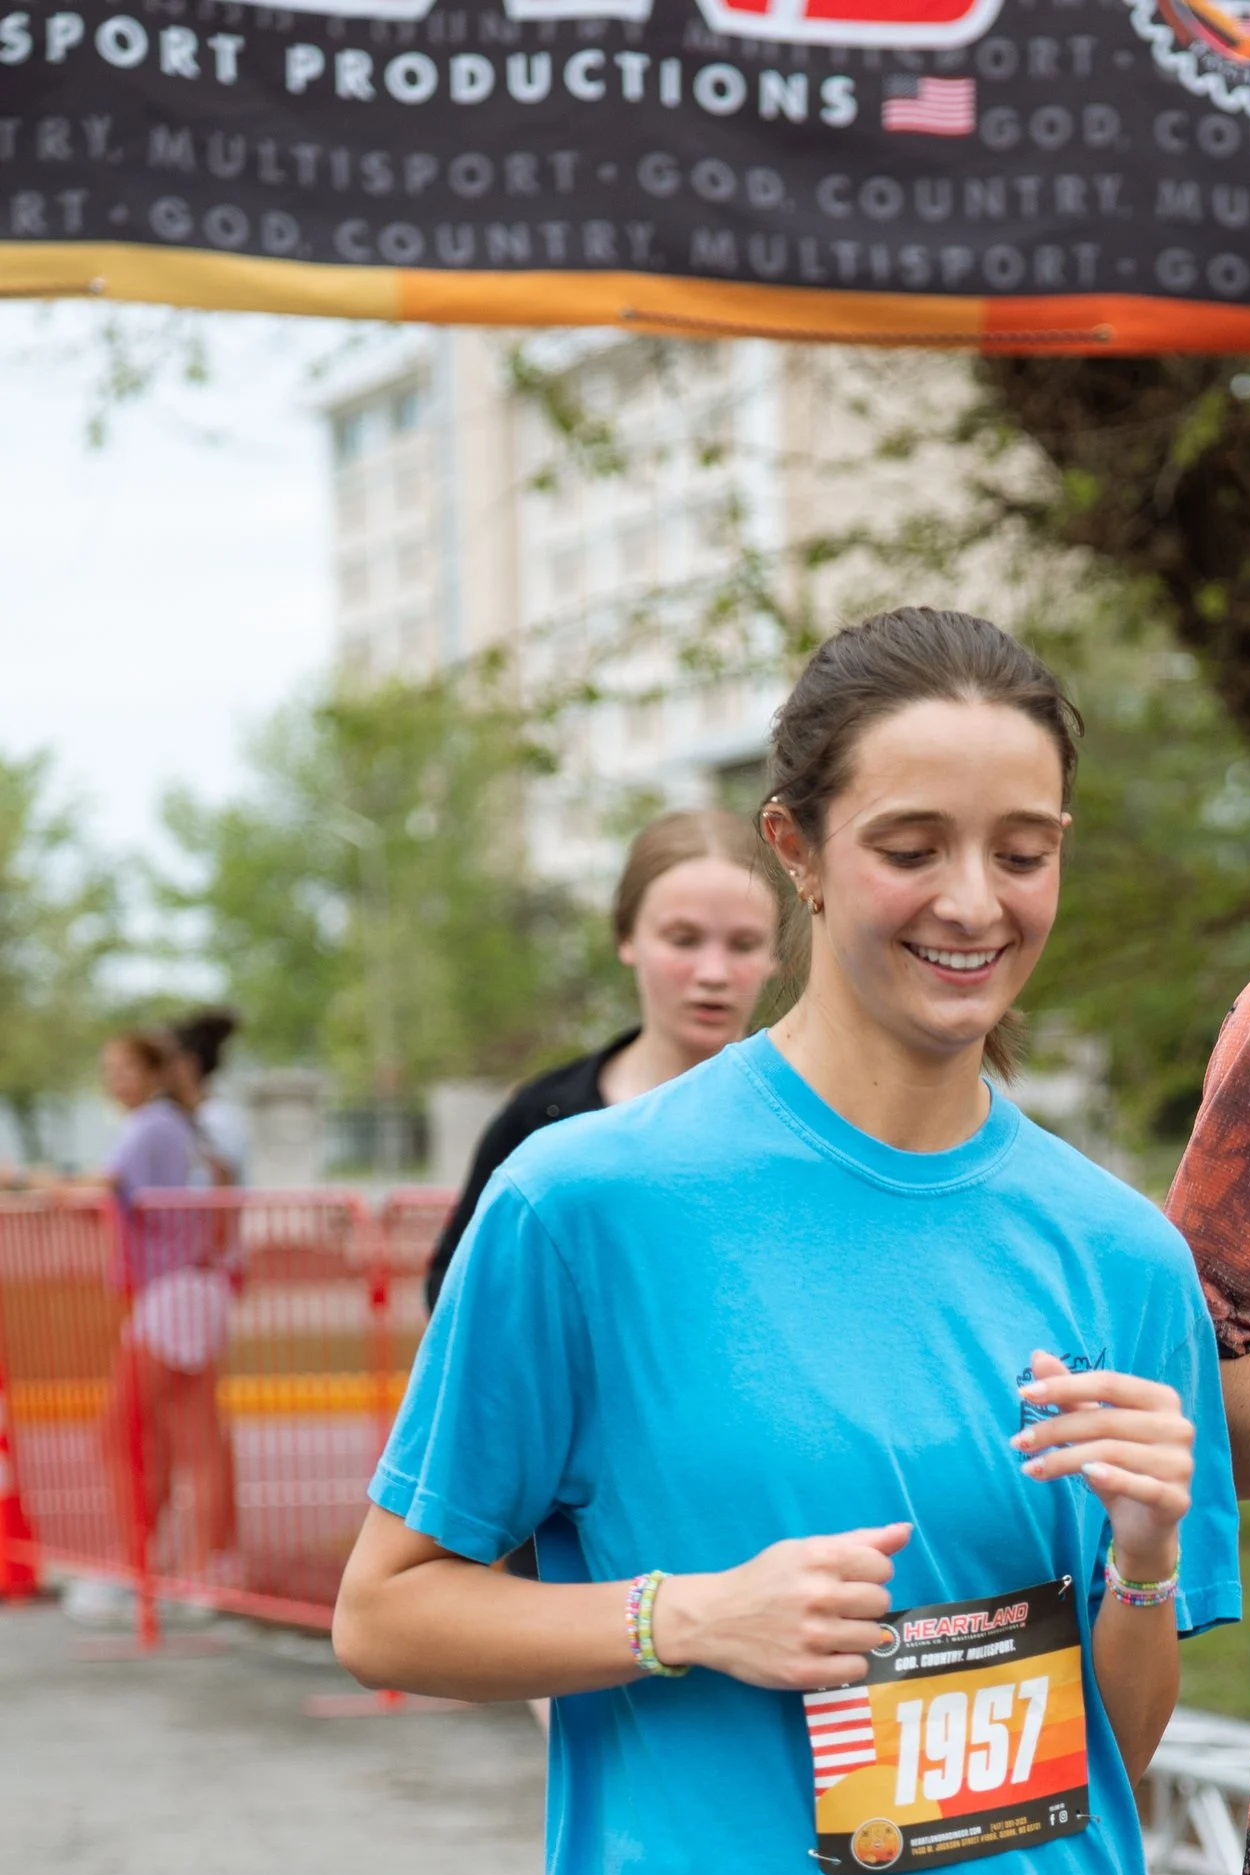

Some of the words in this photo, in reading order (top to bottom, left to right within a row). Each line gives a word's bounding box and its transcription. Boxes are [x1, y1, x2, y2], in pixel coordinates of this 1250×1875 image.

[0, 11, 246, 85] SPORT
[285, 44, 858, 128] PRODUCTIONS
[148, 122, 580, 198] MULTISPORT
[637, 150, 797, 214] GOD.
[815, 172, 1133, 223] COUNTRY.
[979, 103, 1131, 152] GOD.
[148, 195, 313, 260] GOD.
[333, 217, 666, 269] COUNTRY.
[690, 225, 1099, 291] MULTISPORT
[895, 1656, 919, 1671] GOD.
[921, 1649, 965, 1668] COUNTRY.
[966, 1639, 1016, 1661] MULTISPORT.
[904, 1602, 1029, 1642] HEARTLAND
[894, 1675, 1050, 1808] 1957
